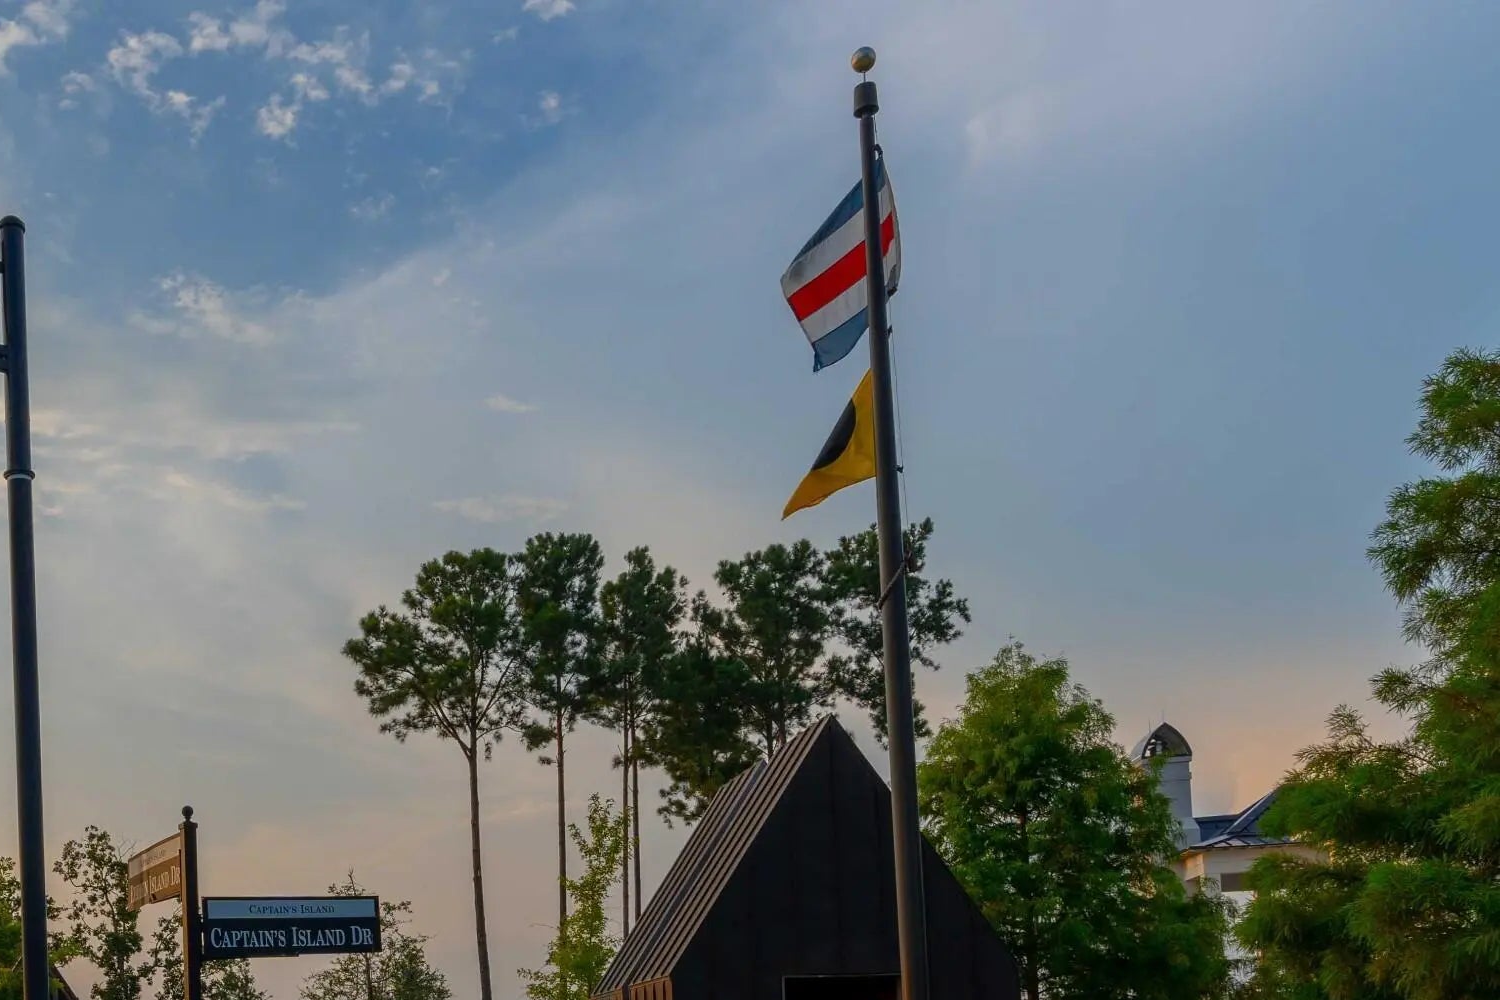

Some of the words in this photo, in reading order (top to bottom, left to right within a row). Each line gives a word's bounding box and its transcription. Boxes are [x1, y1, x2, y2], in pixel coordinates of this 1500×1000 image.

[249, 904, 297, 914] CAPTAIN'S
[300, 904, 335, 913] ISLAND
[210, 927, 286, 948] CAPTAIN'S
[291, 926, 346, 947] ISLAND
[350, 925, 373, 945] DR
